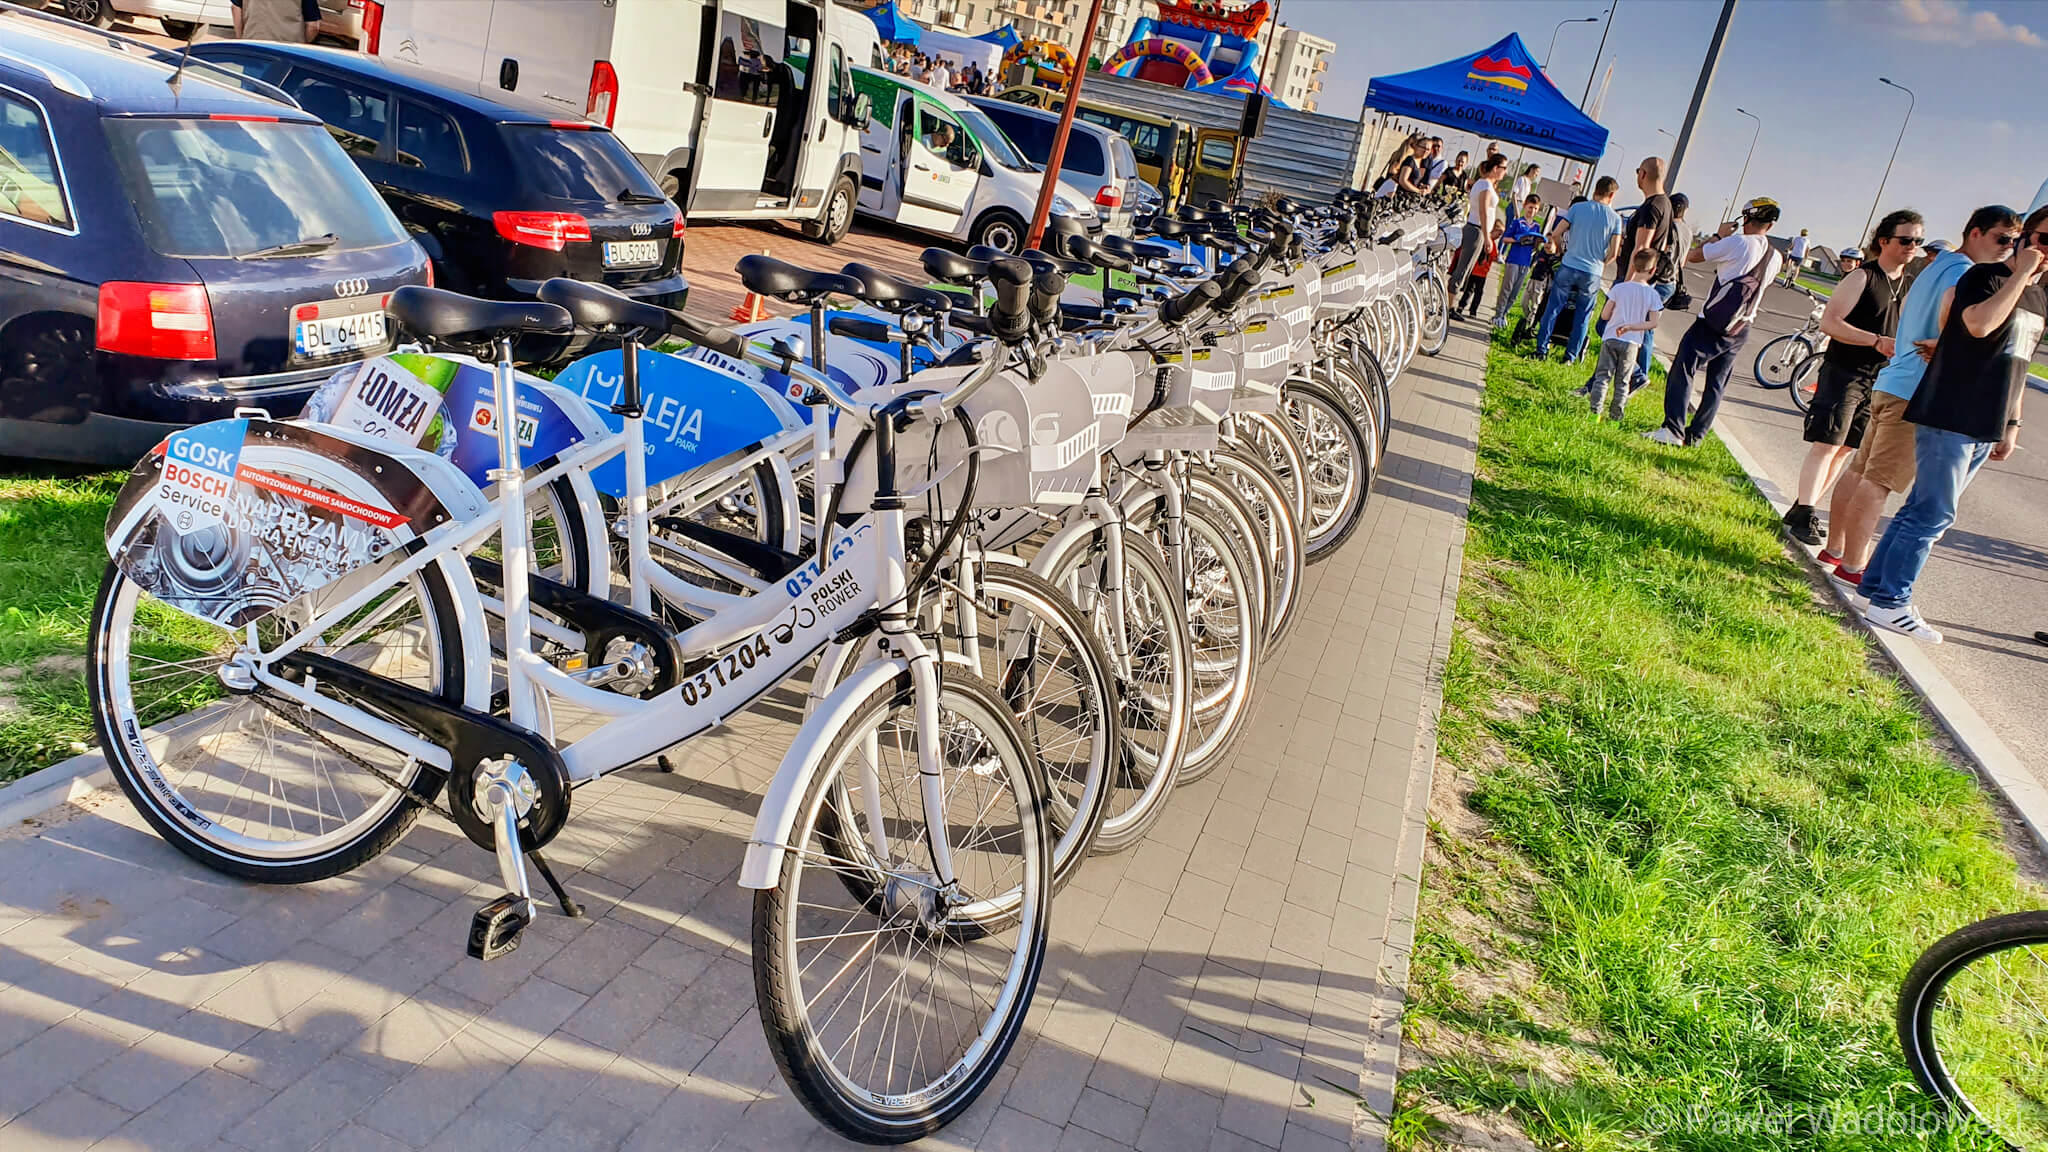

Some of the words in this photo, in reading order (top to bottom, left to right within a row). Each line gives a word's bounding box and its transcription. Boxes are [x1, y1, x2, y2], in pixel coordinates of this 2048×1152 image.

[1415, 98, 1556, 138] www.600.lomza.pl
[611, 244, 626, 261] BL
[629, 243, 657, 260] 52926
[307, 323, 331, 348] BL
[338, 313, 383, 343] 64415
[357, 366, 428, 435] ŁOMŻA
[173, 437, 234, 473] GOSK
[674, 437, 699, 454] PARK
[165, 463, 228, 498] BOSCH
[240, 469, 303, 495] AUTORYZOWANY
[302, 487, 330, 504] SERWIS
[330, 497, 392, 524] SAMOCHODOWY
[160, 484, 221, 517] Service
[811, 568, 853, 605] POLSKI
[817, 582, 862, 617] ROWER
[681, 633, 771, 706] 031204
